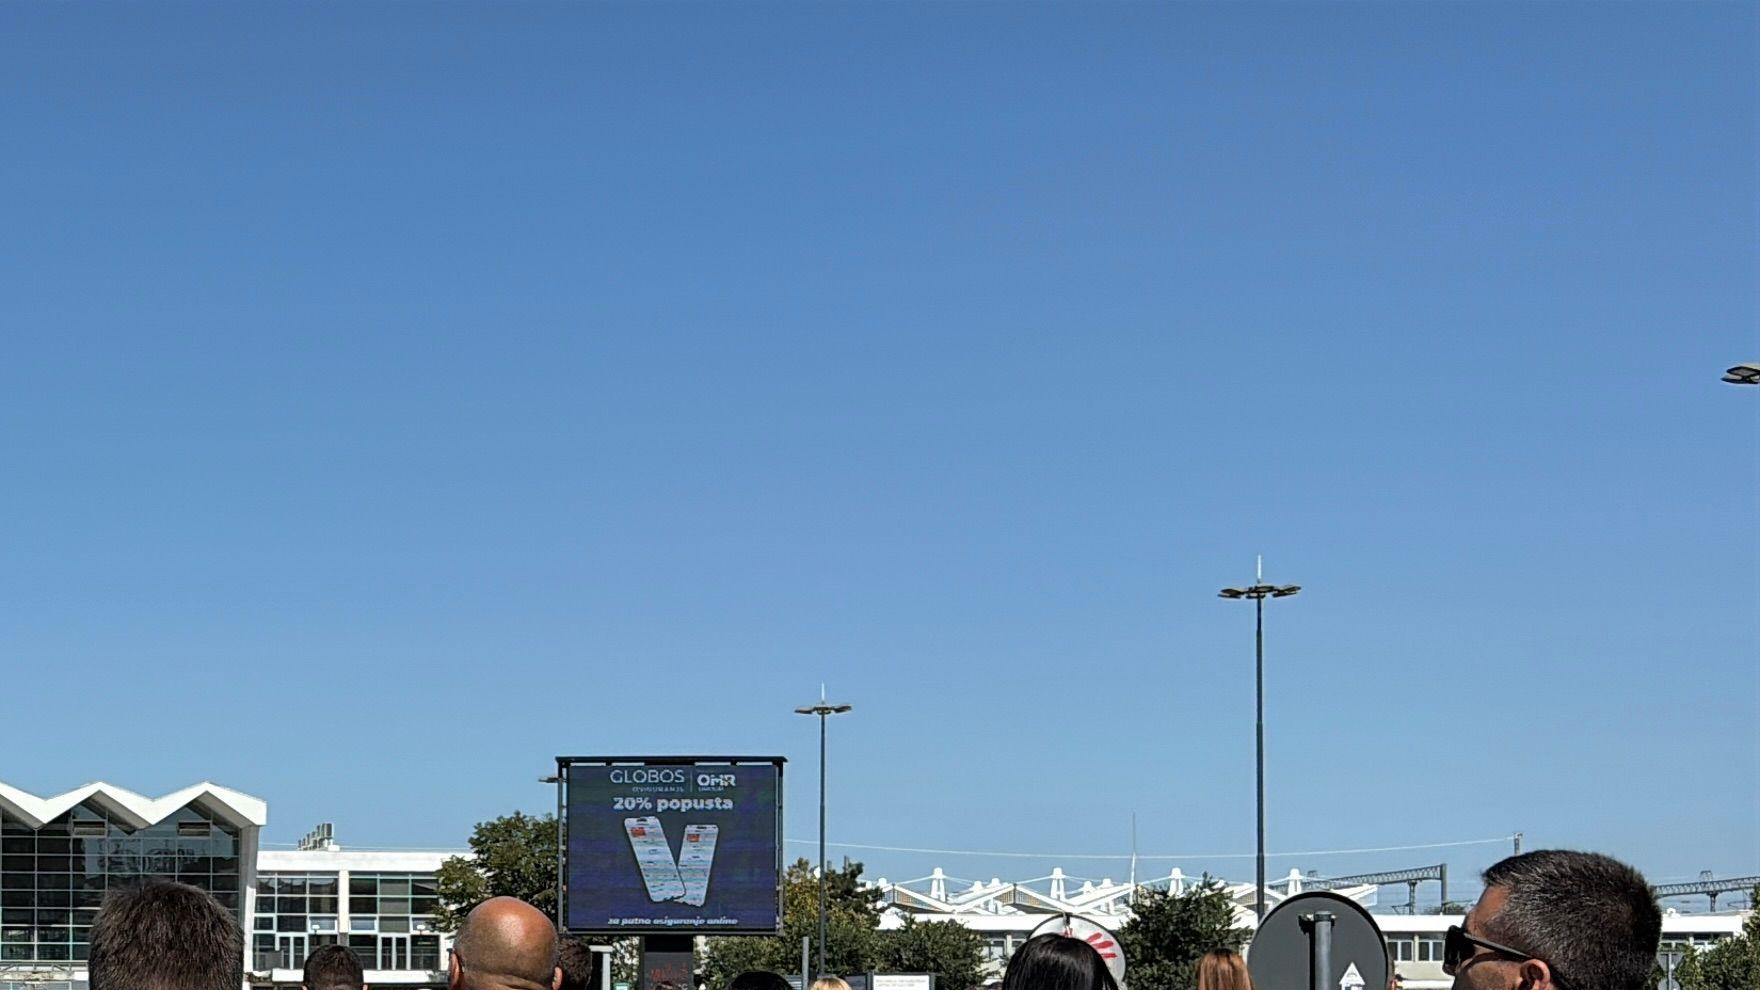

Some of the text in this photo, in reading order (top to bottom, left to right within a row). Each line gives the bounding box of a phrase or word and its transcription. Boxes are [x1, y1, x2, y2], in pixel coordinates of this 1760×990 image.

[609, 769, 685, 784] GLOBOS
[613, 797, 734, 812] 20% popusta
[653, 915, 705, 926] osiguranje
